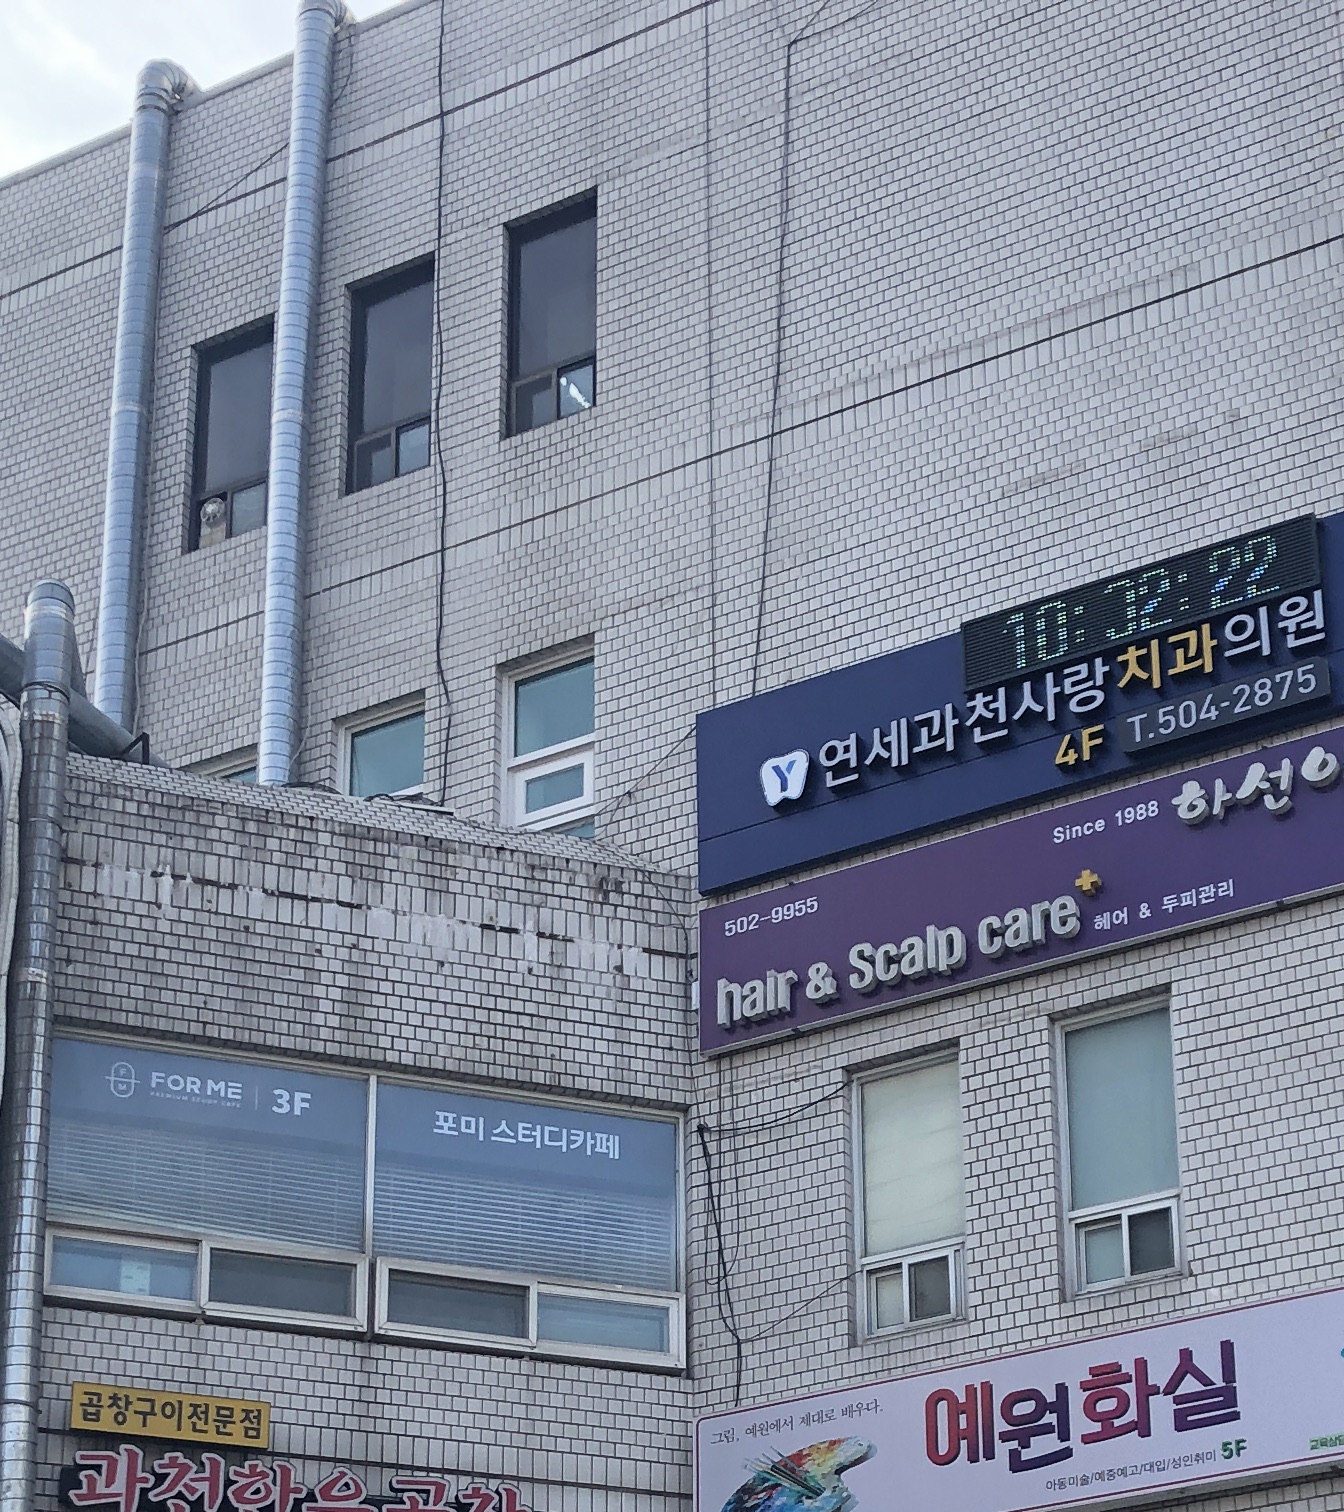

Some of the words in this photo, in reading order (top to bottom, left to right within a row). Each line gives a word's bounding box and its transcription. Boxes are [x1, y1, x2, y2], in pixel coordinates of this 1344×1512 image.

[1055, 725, 1106, 767] 4F
[1125, 664, 1319, 746] T.504-2875
[1052, 816, 1107, 845] Since
[1114, 800, 1160, 829] 1988
[722, 896, 820, 938] 502-9955
[1093, 906, 1129, 931] 헤어
[1138, 902, 1153, 919] &
[1161, 878, 1234, 914] 두피관리
[715, 966, 800, 1030] hair
[806, 961, 838, 1004] &
[848, 921, 968, 994] Scalp
[977, 889, 1084, 959] care
[270, 1088, 312, 1116] 3F
[432, 1109, 485, 1142] 포미
[489, 1119, 622, 1160] 스터디카페
[78, 1389, 264, 1441] 곱창구이전문점
[745, 1415, 794, 1439] 예원에서
[799, 1408, 837, 1427] 제대로
[924, 1339, 1242, 1474] 예원화실
[1220, 1437, 1248, 1460] 5F
